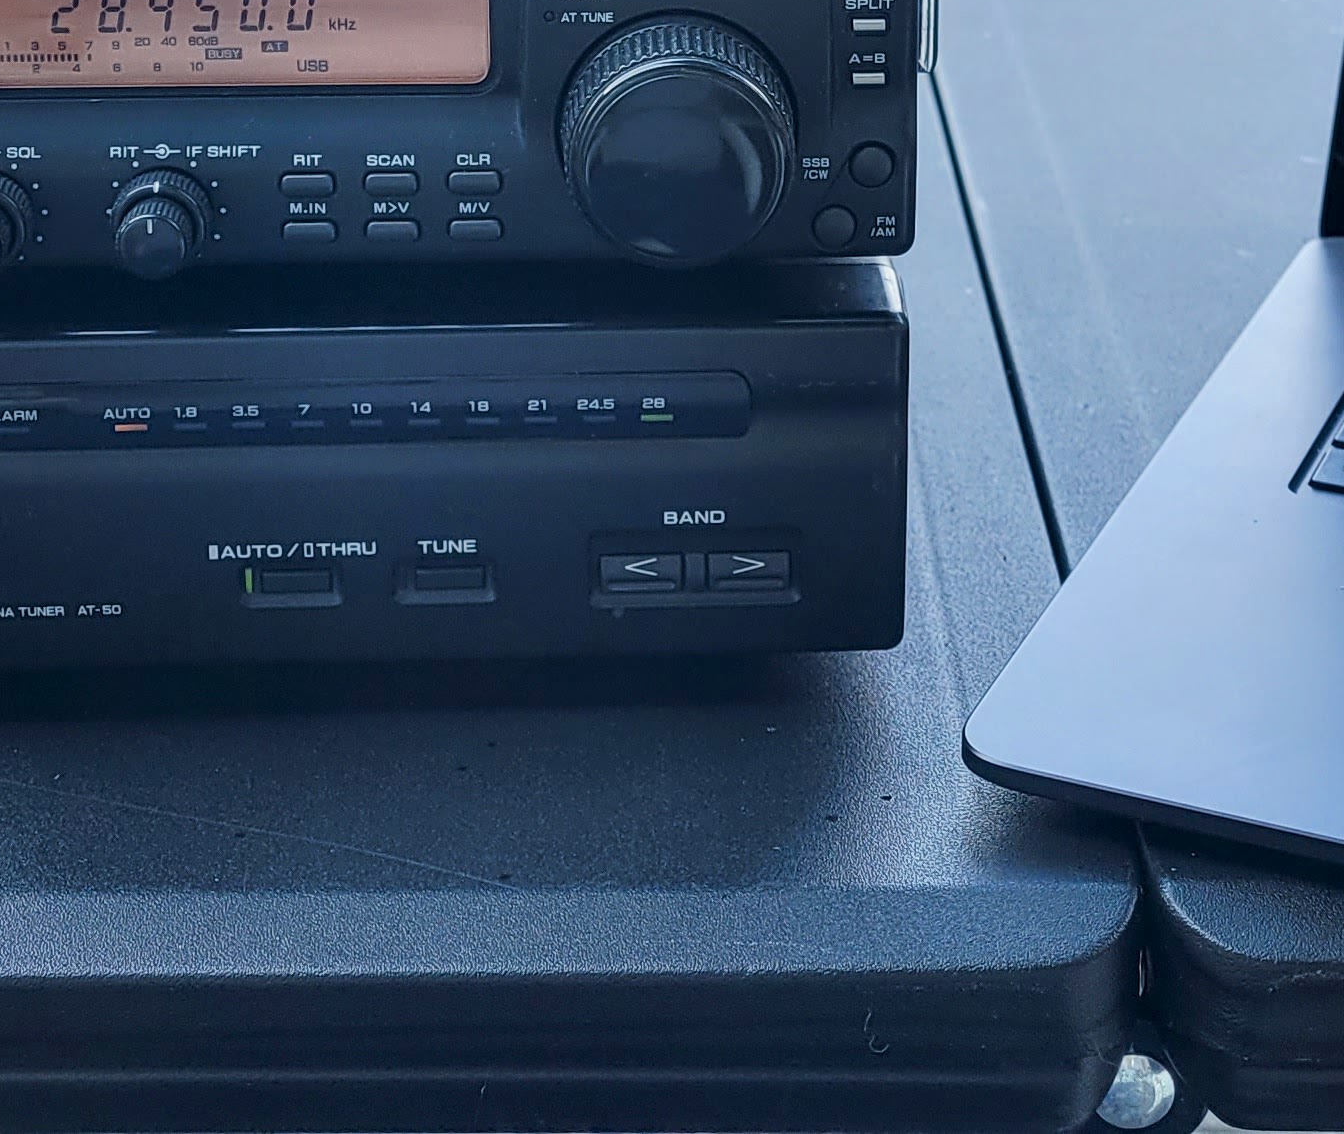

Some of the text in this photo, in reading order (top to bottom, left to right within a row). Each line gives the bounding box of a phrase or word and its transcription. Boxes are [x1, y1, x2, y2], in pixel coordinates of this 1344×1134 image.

[328, 17, 357, 31] kHz
[560, 12, 615, 24] AT TUNE
[207, 42, 284, 60] BUSY AT
[848, 52, 887, 65] A=B
[296, 59, 329, 73] USB
[5, 145, 42, 160] SQL
[109, 145, 261, 159] RIT IF SHIFT
[456, 152, 491, 166] CLR
[293, 154, 323, 167] RIT
[365, 153, 415, 167] SCAN
[801, 157, 831, 168] SSB
[803, 169, 829, 180] /CW
[289, 202, 327, 215] M.IN
[373, 201, 410, 214] M>V
[458, 201, 491, 214] M/V
[876, 215, 896, 226] FM
[870, 227, 896, 238] /AM
[102, 397, 666, 421] AUTO 1.8 3.5 7 10 14 18 21 24.5 28
[662, 509, 727, 526] BAND
[219, 540, 378, 560] AUTO THRU
[416, 538, 478, 555] TUNE
[18, 604, 66, 619] TUNER
[77, 603, 123, 617] AT-50
